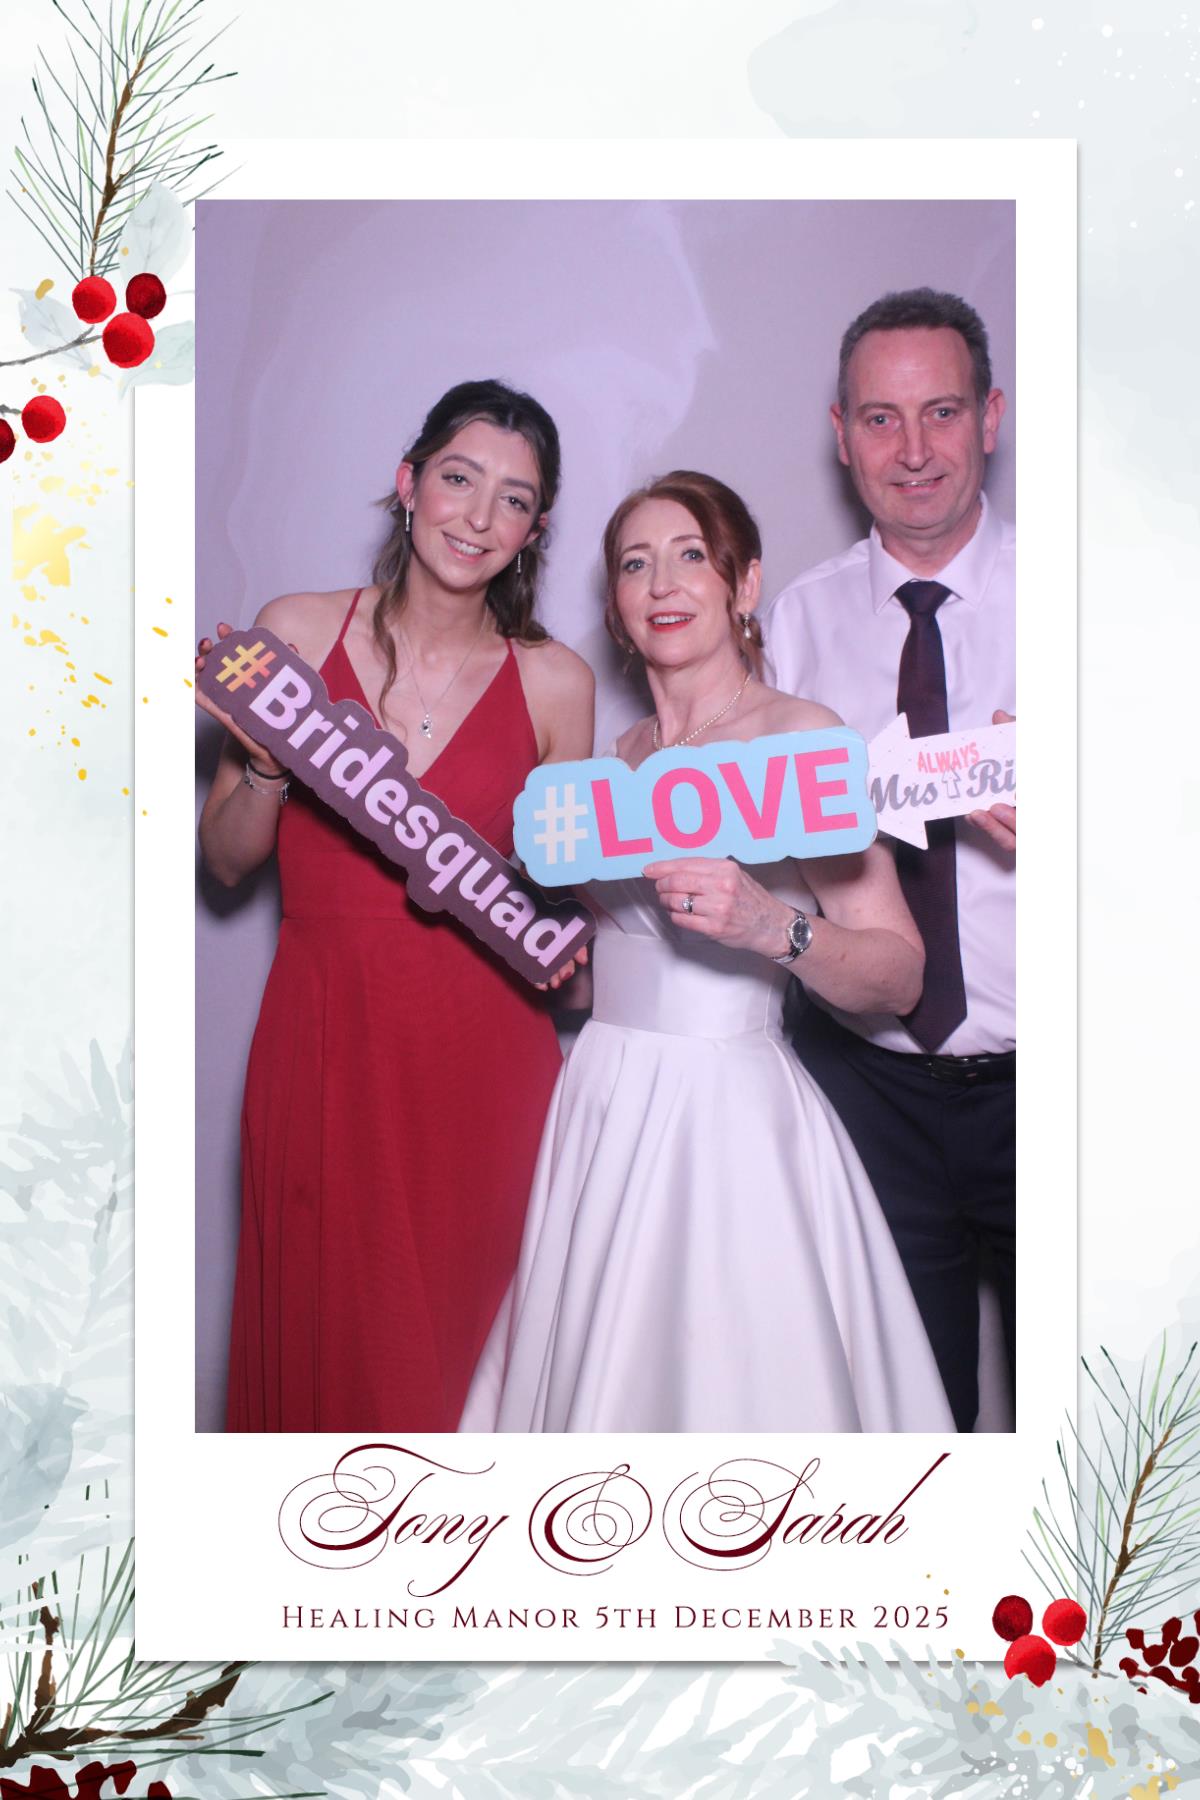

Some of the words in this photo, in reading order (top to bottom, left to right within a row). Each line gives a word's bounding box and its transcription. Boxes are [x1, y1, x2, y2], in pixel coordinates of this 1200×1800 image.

[870, 773, 938, 813] Mrs
[916, 742, 980, 774] ALWAYS
[215, 640, 587, 968] #Bridesquad
[533, 747, 858, 865] #LOVE
